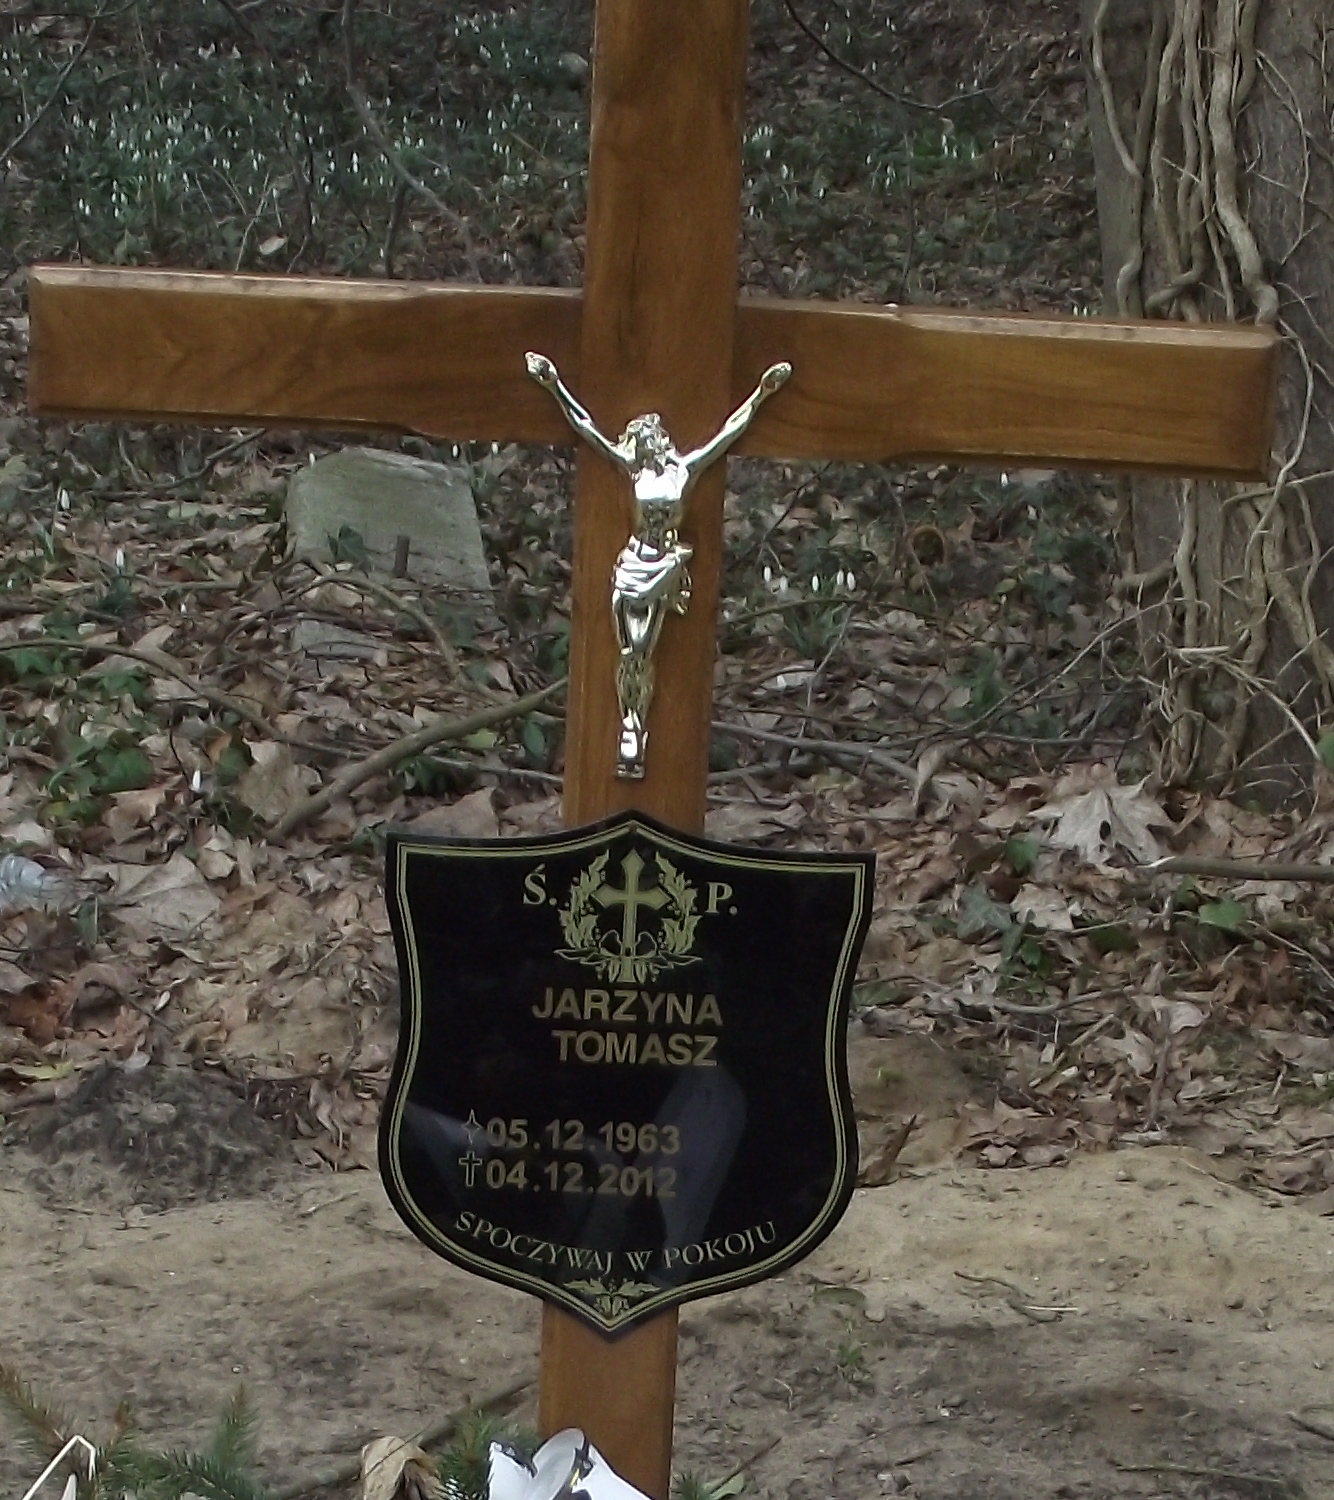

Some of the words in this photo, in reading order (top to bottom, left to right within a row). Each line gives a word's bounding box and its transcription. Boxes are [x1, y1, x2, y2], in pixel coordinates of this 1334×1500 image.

[706, 881, 738, 915] P.
[532, 987, 724, 1026] JARZYNA
[552, 1030, 718, 1066] TOMASZ
[455, 1211, 614, 1274] SPOCZYWAJ
[626, 1250, 652, 1272] W
[665, 1221, 776, 1269] POKOJU
